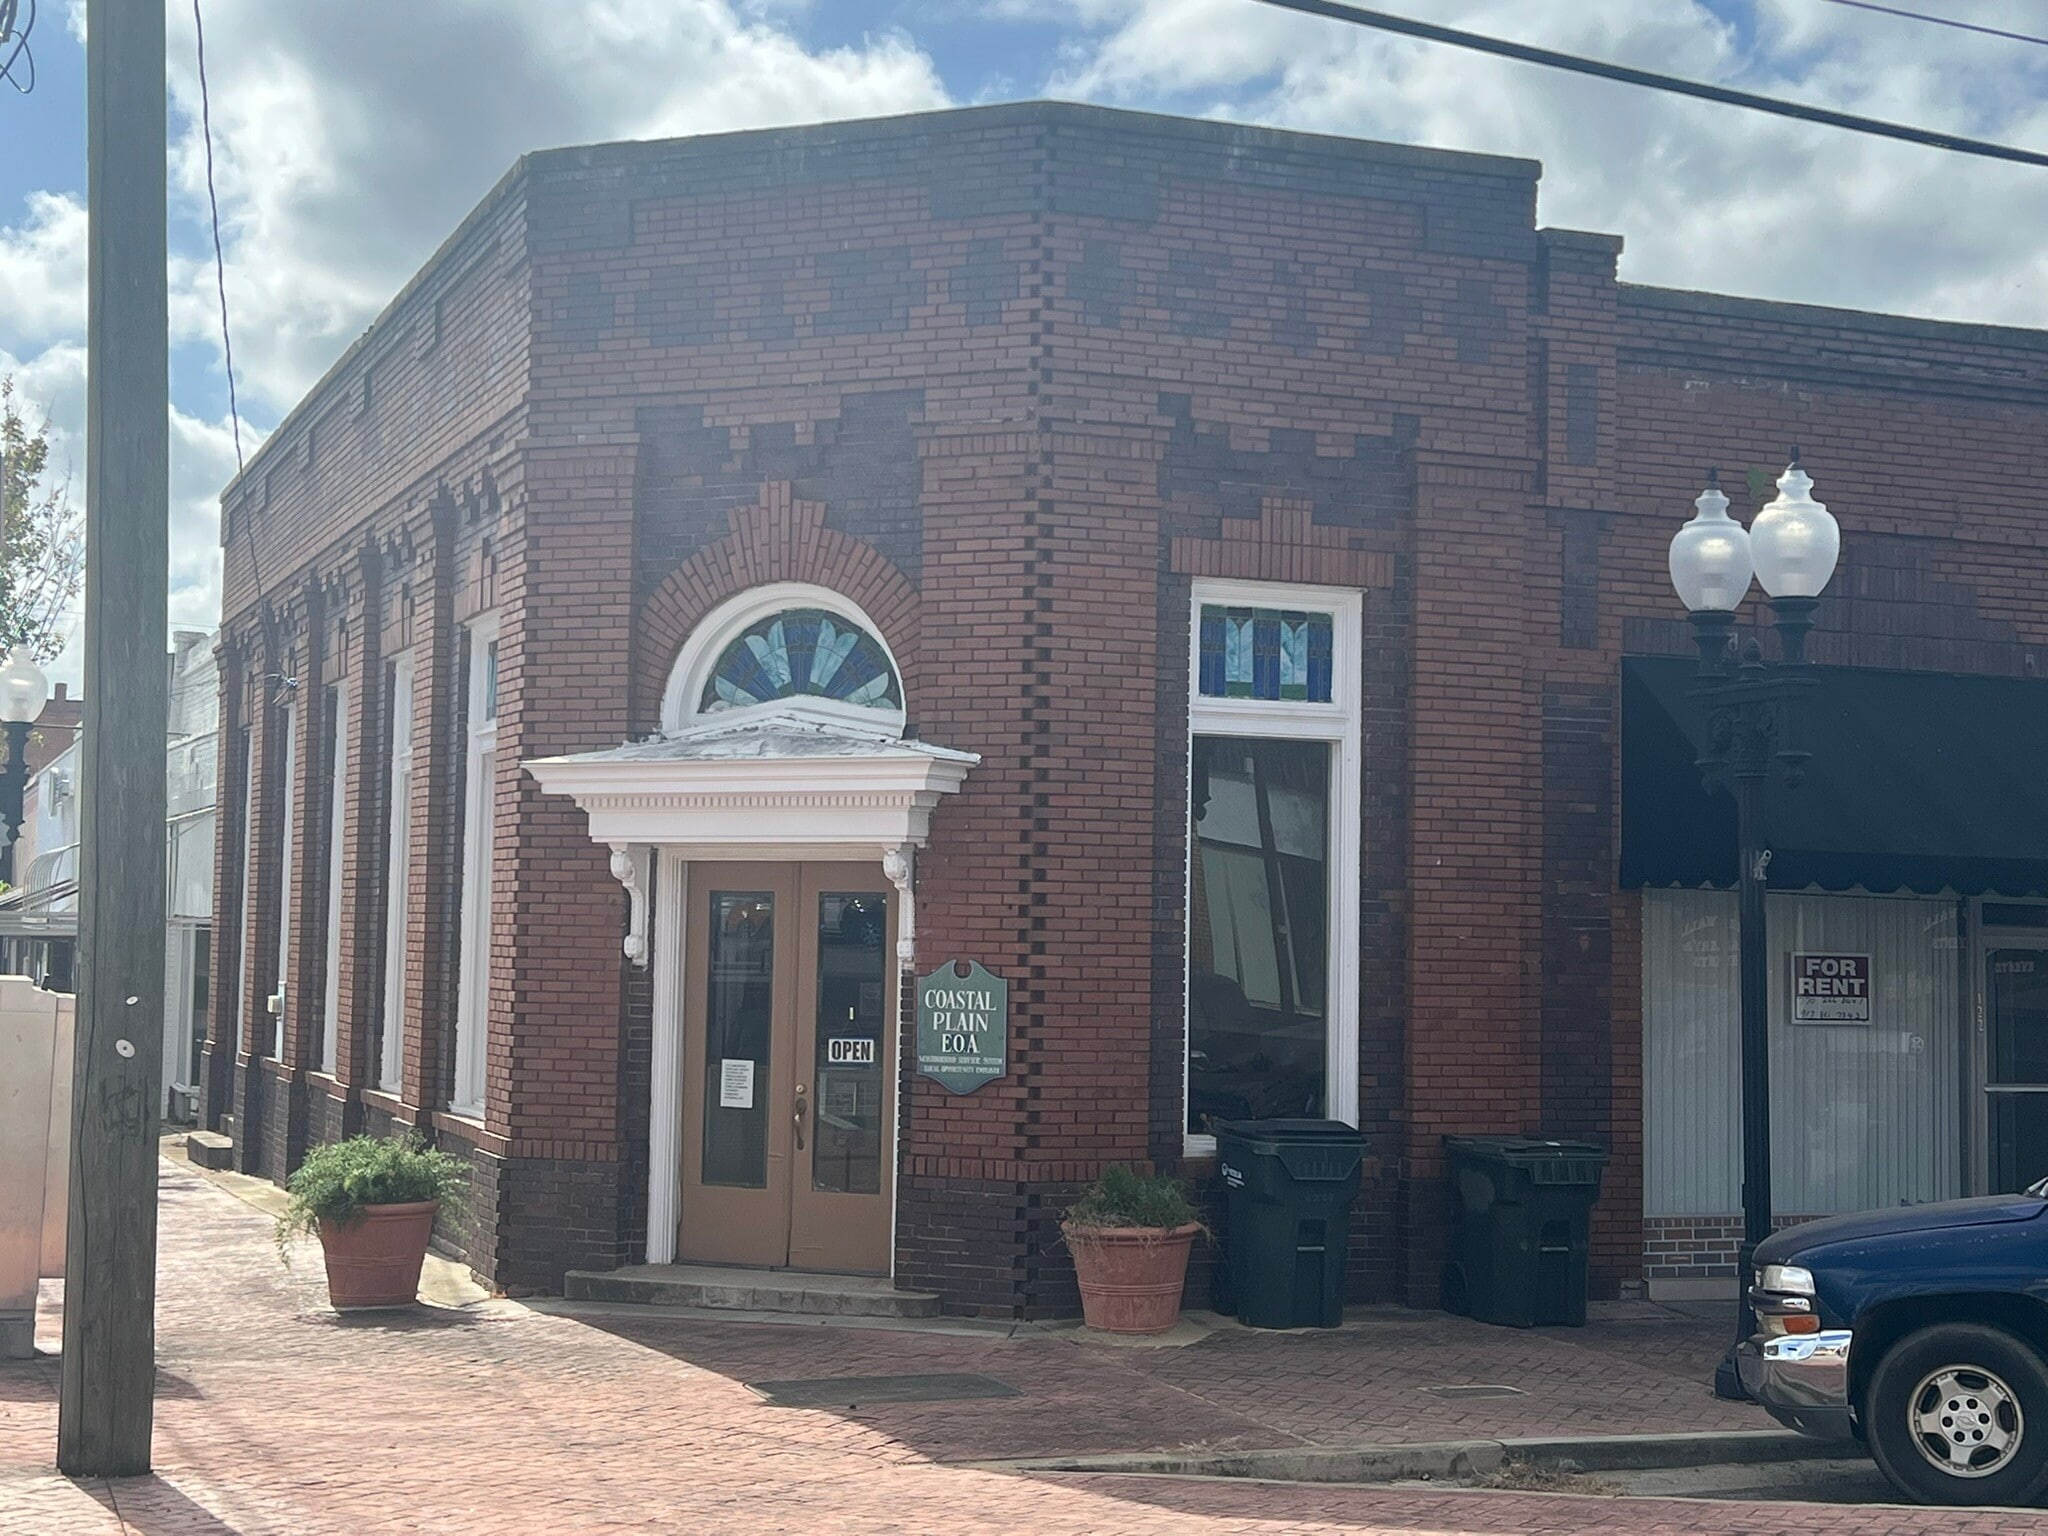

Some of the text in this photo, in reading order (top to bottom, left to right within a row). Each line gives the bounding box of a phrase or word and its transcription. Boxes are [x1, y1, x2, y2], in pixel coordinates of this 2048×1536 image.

[1806, 958, 1857, 976] FOR
[1798, 977, 1865, 995] RENT
[925, 989, 997, 1011] COASTAL
[933, 1012, 989, 1032] PLAIN
[832, 1041, 871, 1060] OPEN
